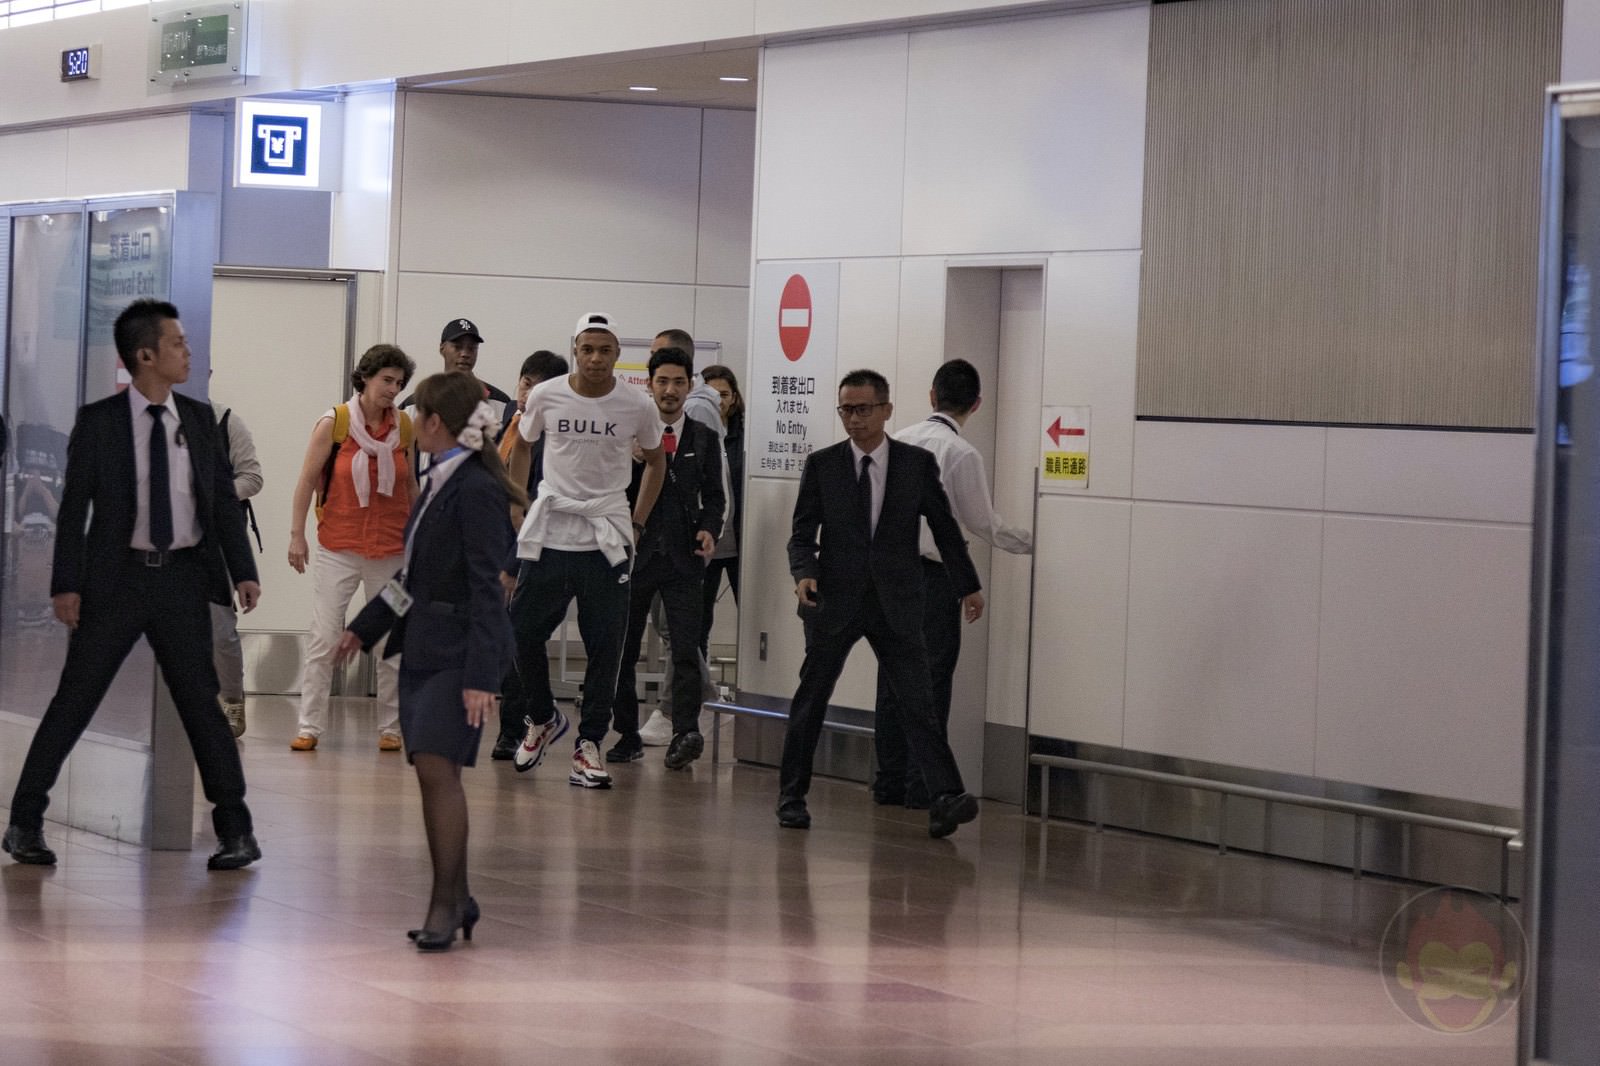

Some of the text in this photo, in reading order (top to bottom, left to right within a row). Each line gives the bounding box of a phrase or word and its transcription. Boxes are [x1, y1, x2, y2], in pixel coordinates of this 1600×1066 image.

[68, 50, 88, 75] 5:20
[137, 272, 154, 295] Exit
[772, 376, 815, 395] 到着客出口
[776, 400, 809, 414] 入れません
[558, 420, 617, 436] BULK
[776, 420, 807, 440] No Entry
